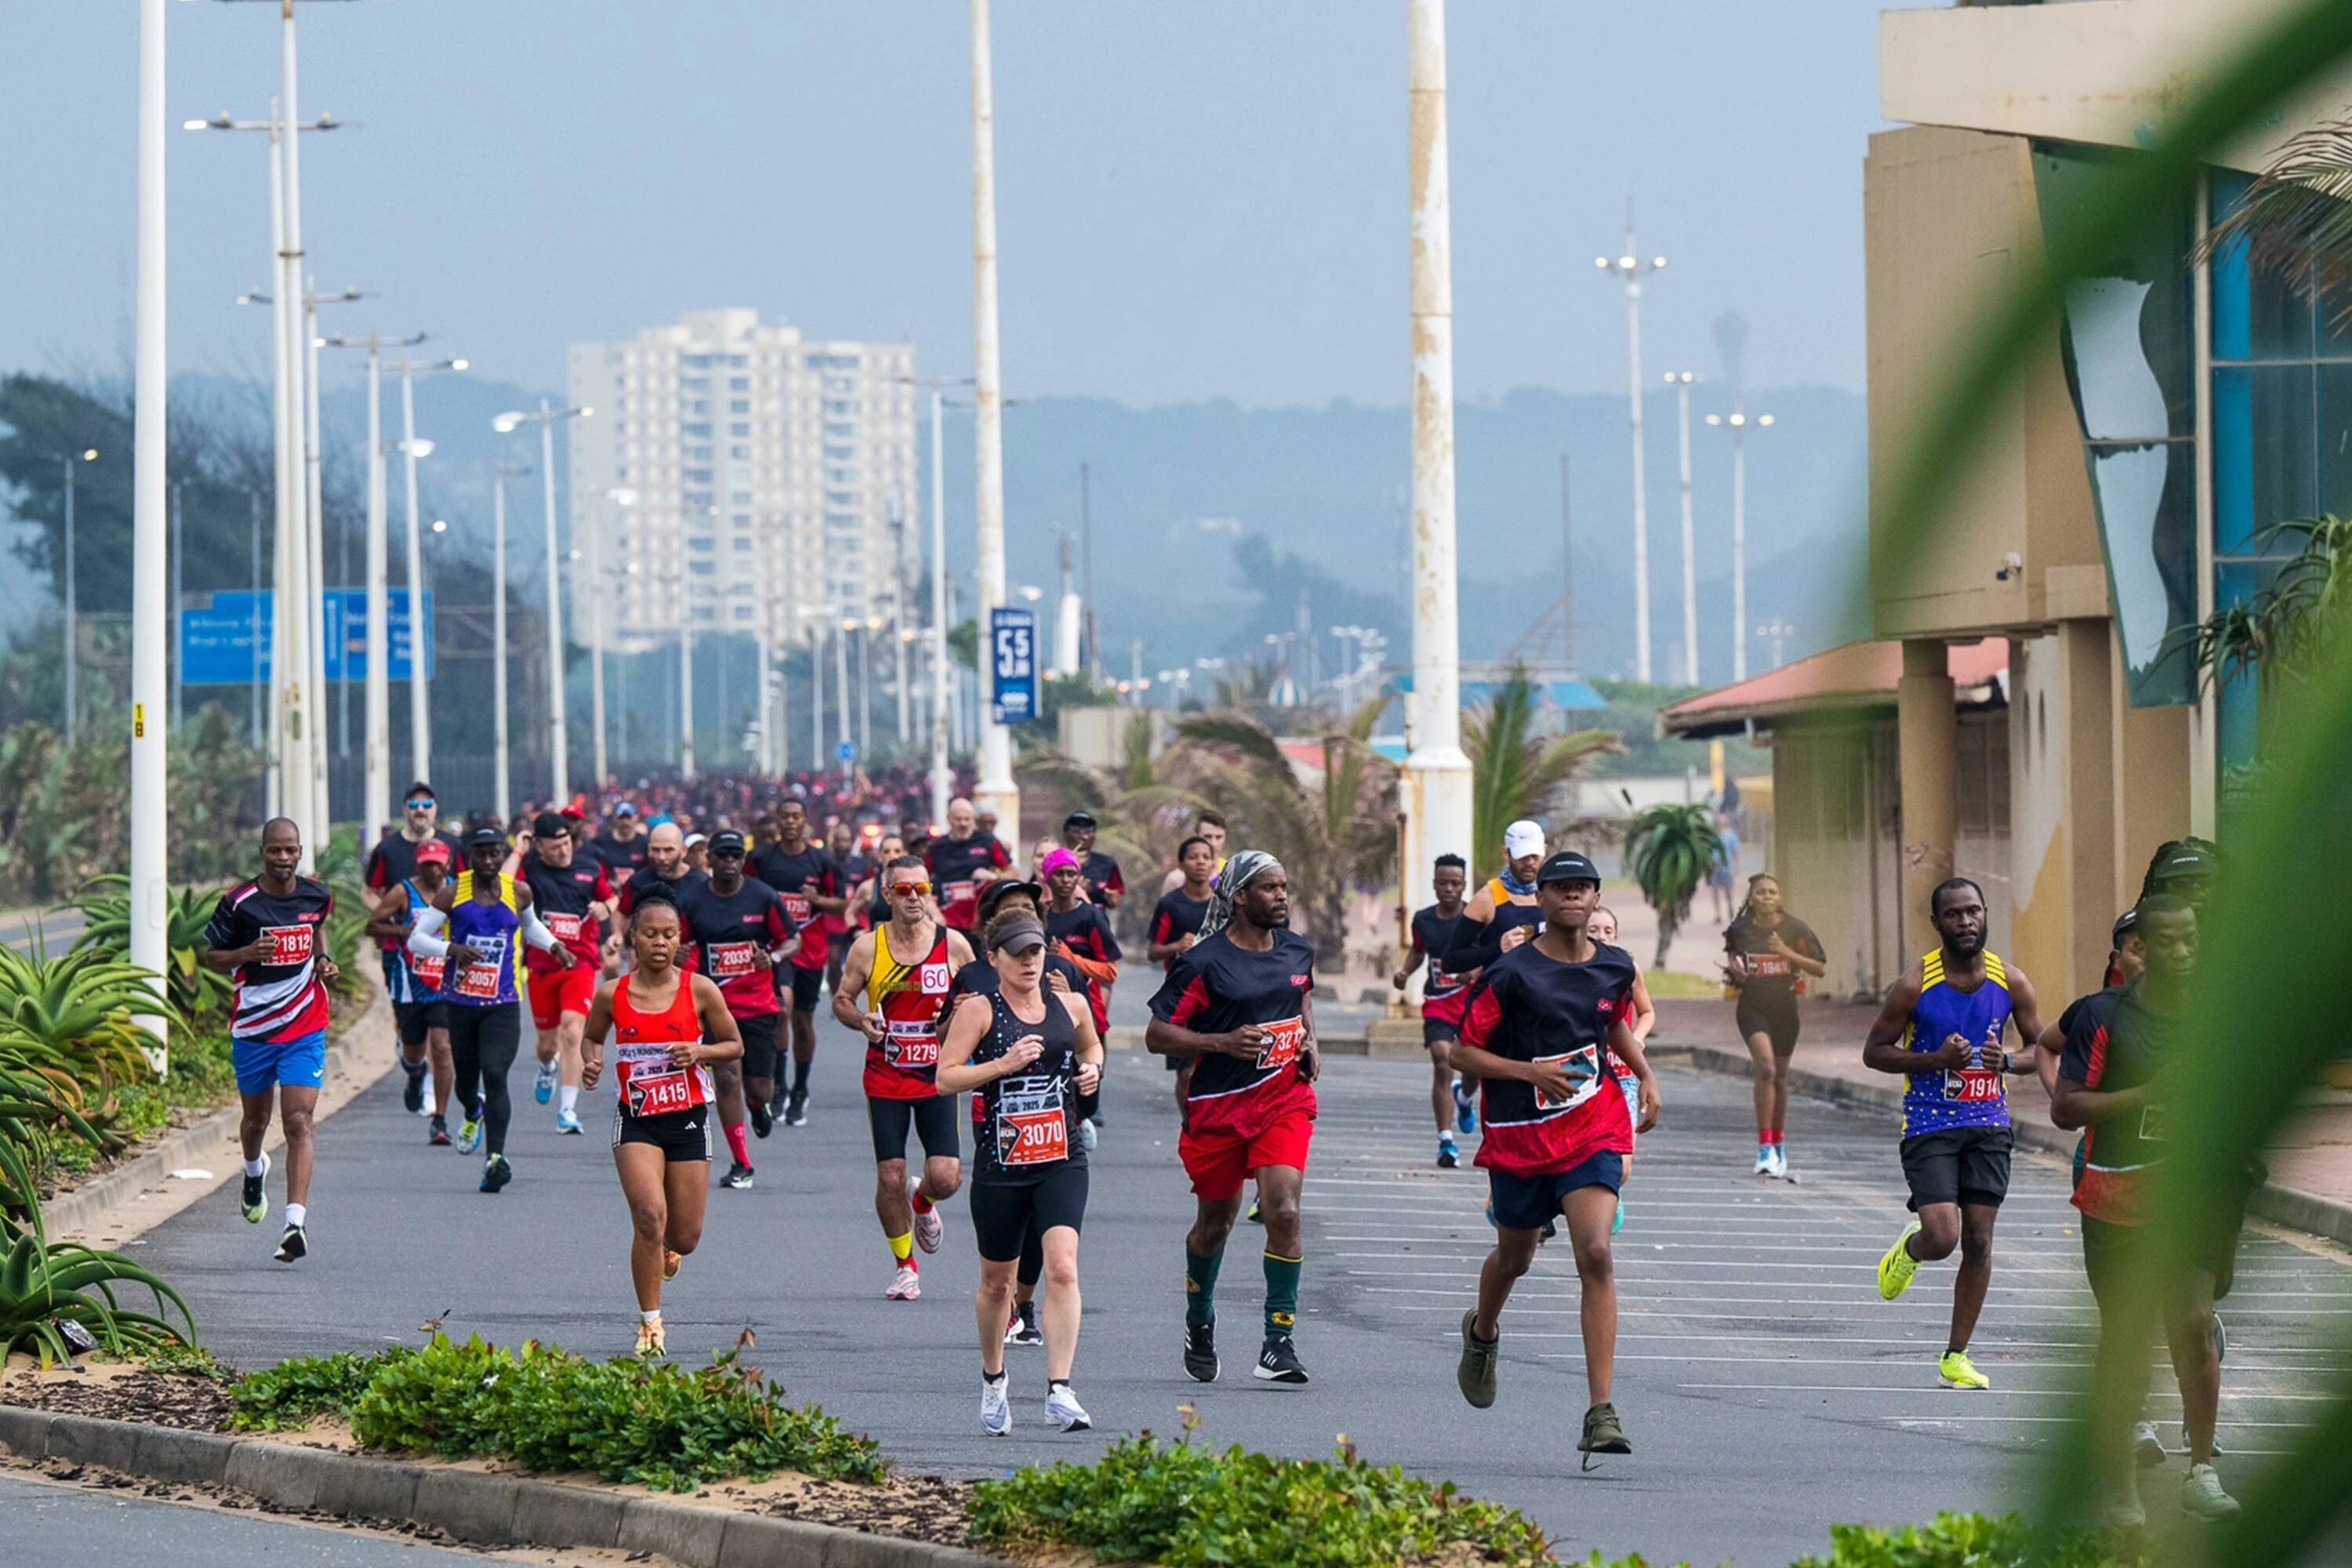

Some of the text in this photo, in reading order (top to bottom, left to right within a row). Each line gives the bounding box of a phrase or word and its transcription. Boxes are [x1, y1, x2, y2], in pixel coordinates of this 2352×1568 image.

[281, 933, 310, 952] 1812
[723, 949, 750, 965] 2033
[467, 970, 497, 987] 3057
[923, 968, 947, 989] 60
[905, 1044, 937, 1062] 1279
[649, 1081, 686, 1106] 1415
[1969, 1076, 1998, 1098] 1914
[1022, 1120, 1063, 1147] 3070
